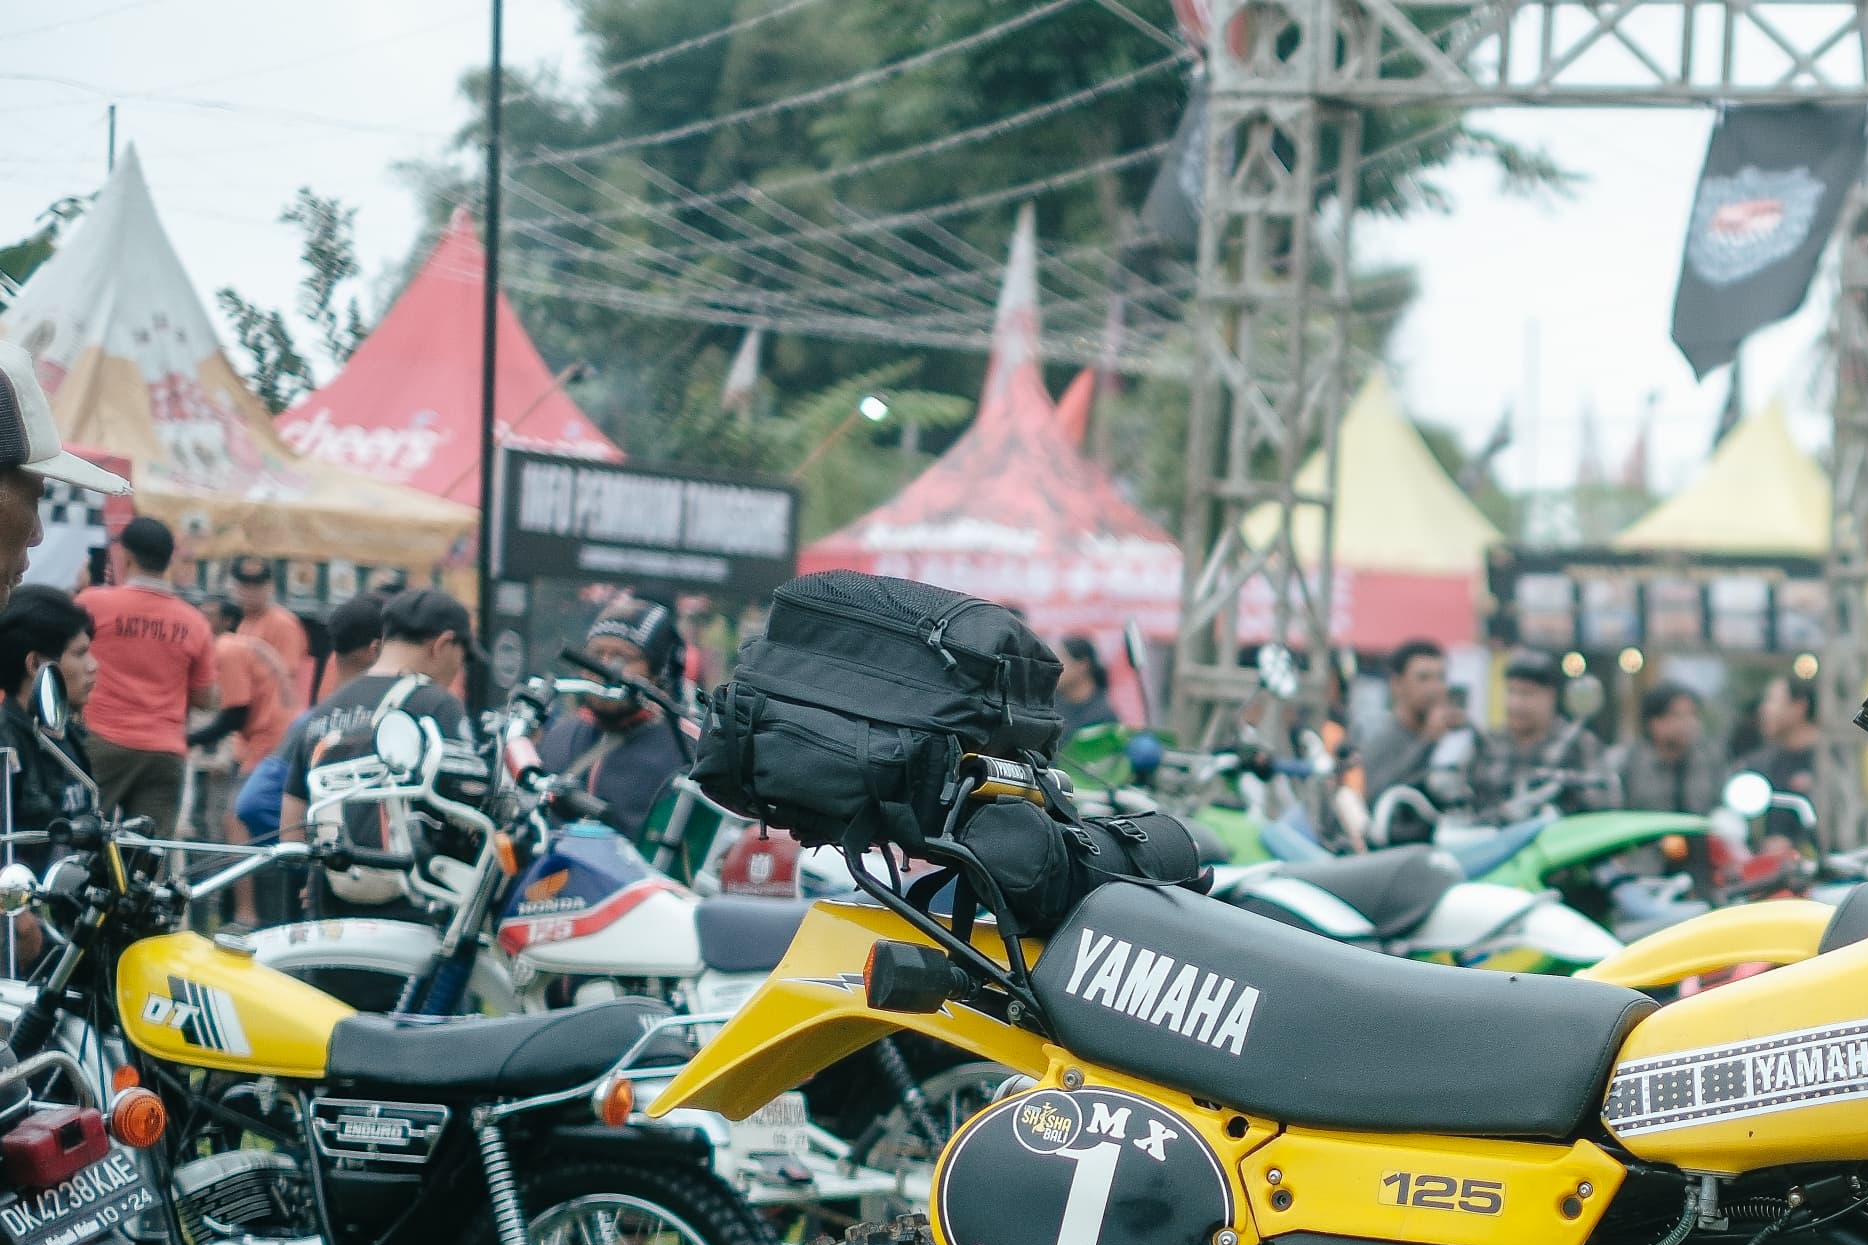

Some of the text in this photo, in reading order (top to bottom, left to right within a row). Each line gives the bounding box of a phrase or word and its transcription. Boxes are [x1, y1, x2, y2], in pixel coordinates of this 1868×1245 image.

[518, 895, 586, 916] HONDA
[1064, 927, 1261, 1055] YAMAHA
[142, 991, 201, 1029] DT
[344, 1120, 403, 1139] ENDURO
[1042, 1127, 1069, 1144] BALI
[1382, 1172, 1505, 1215] 125
